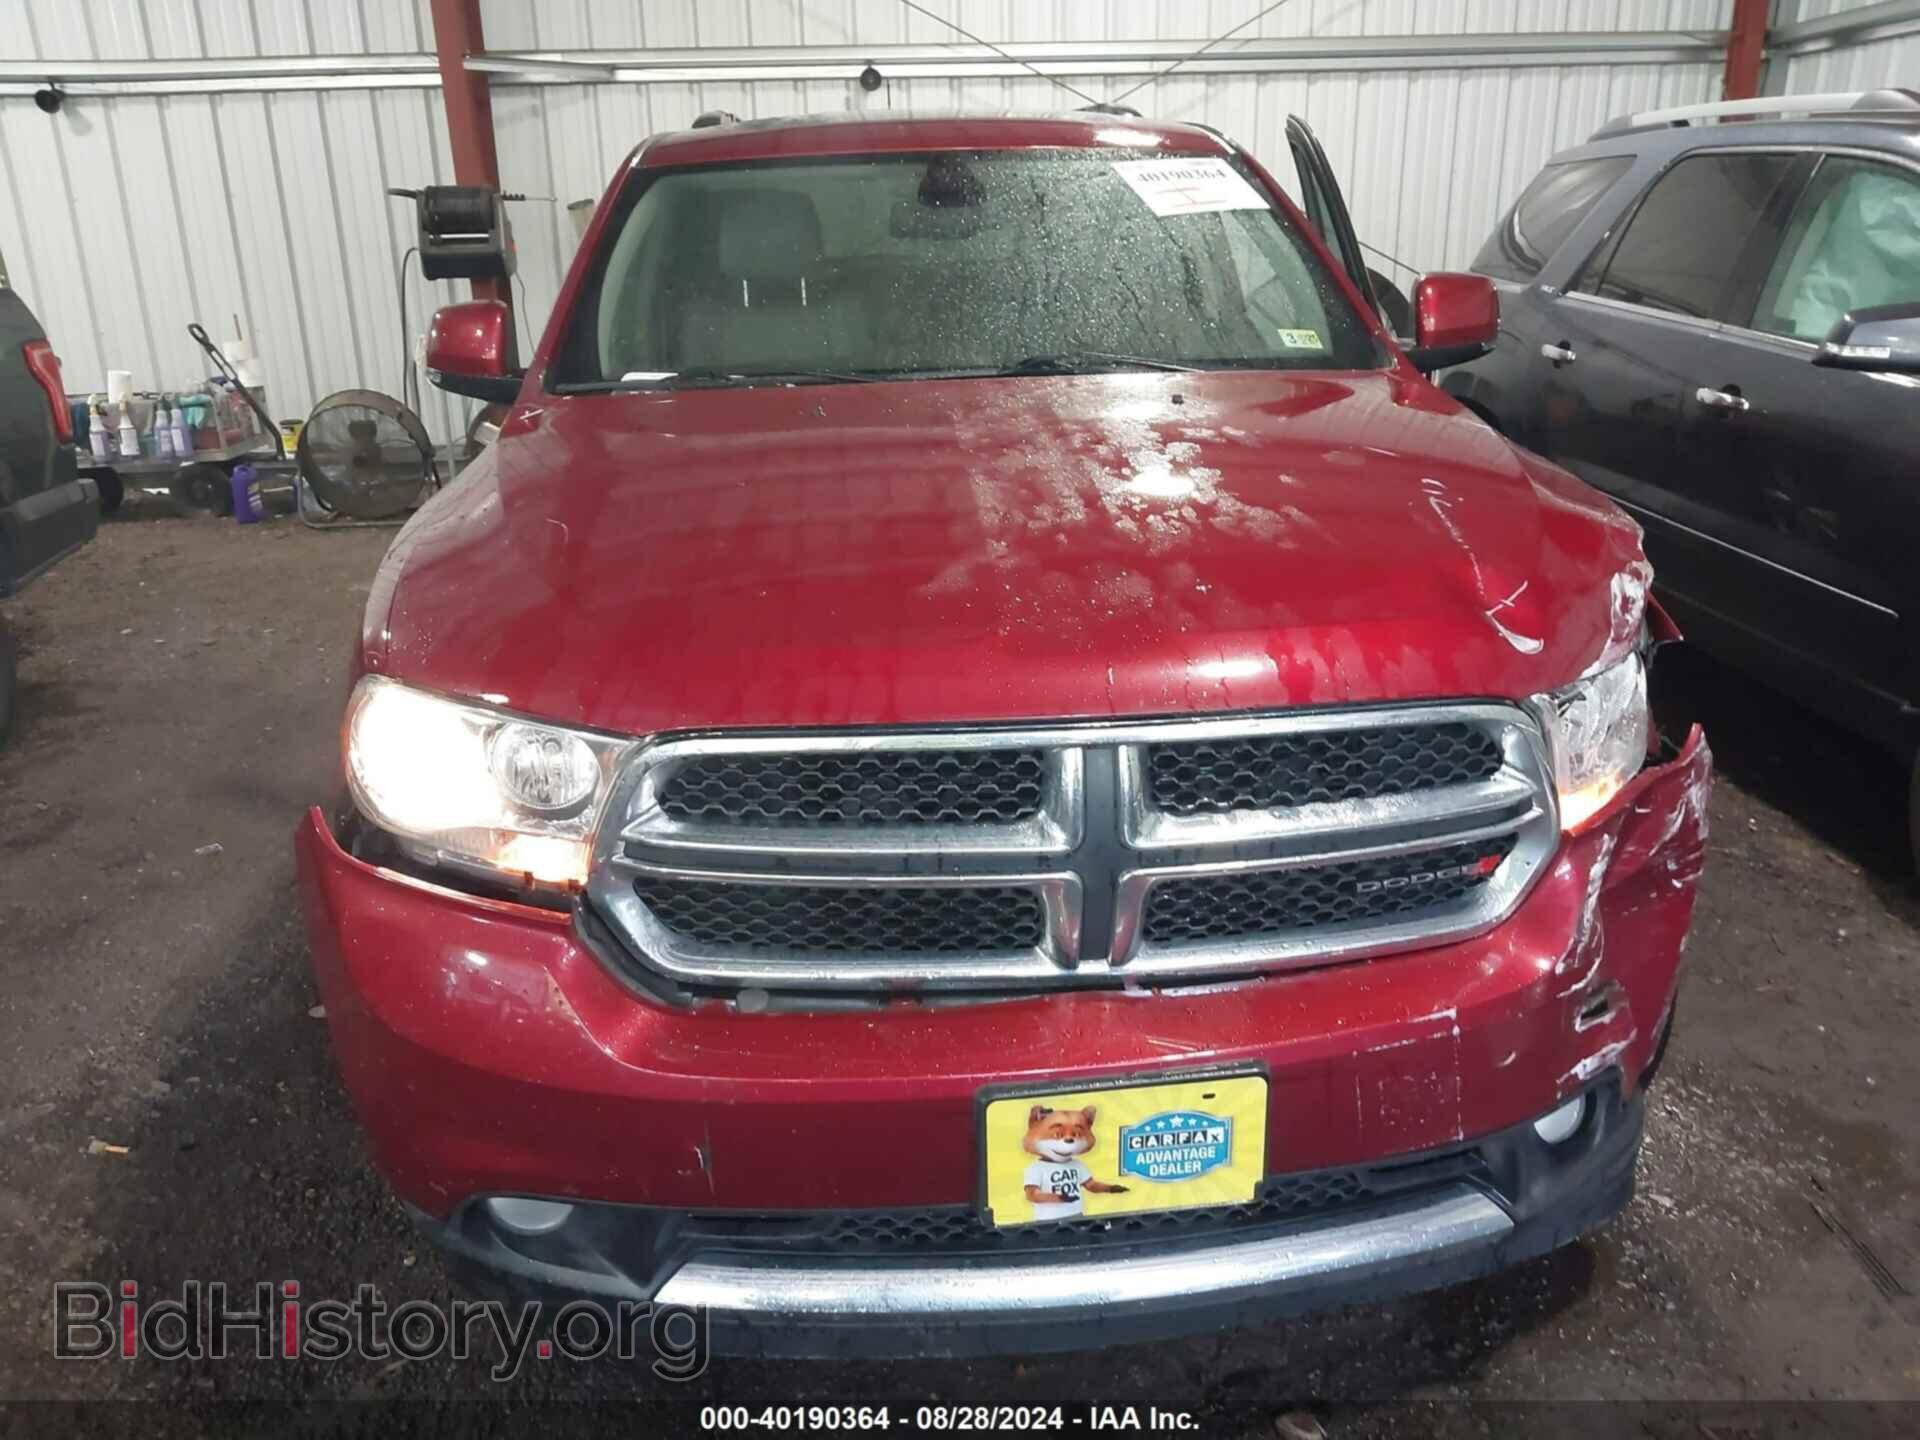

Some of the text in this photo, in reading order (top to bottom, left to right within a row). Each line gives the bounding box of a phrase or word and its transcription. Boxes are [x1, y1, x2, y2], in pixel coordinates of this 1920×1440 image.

[1129, 1127, 1225, 1149] CARFAX
[1135, 1145, 1216, 1165] ADVANTAGE
[1050, 1169, 1079, 1183] CAR
[1149, 1160, 1202, 1177] DEALER
[1051, 1182, 1080, 1196] FOX
